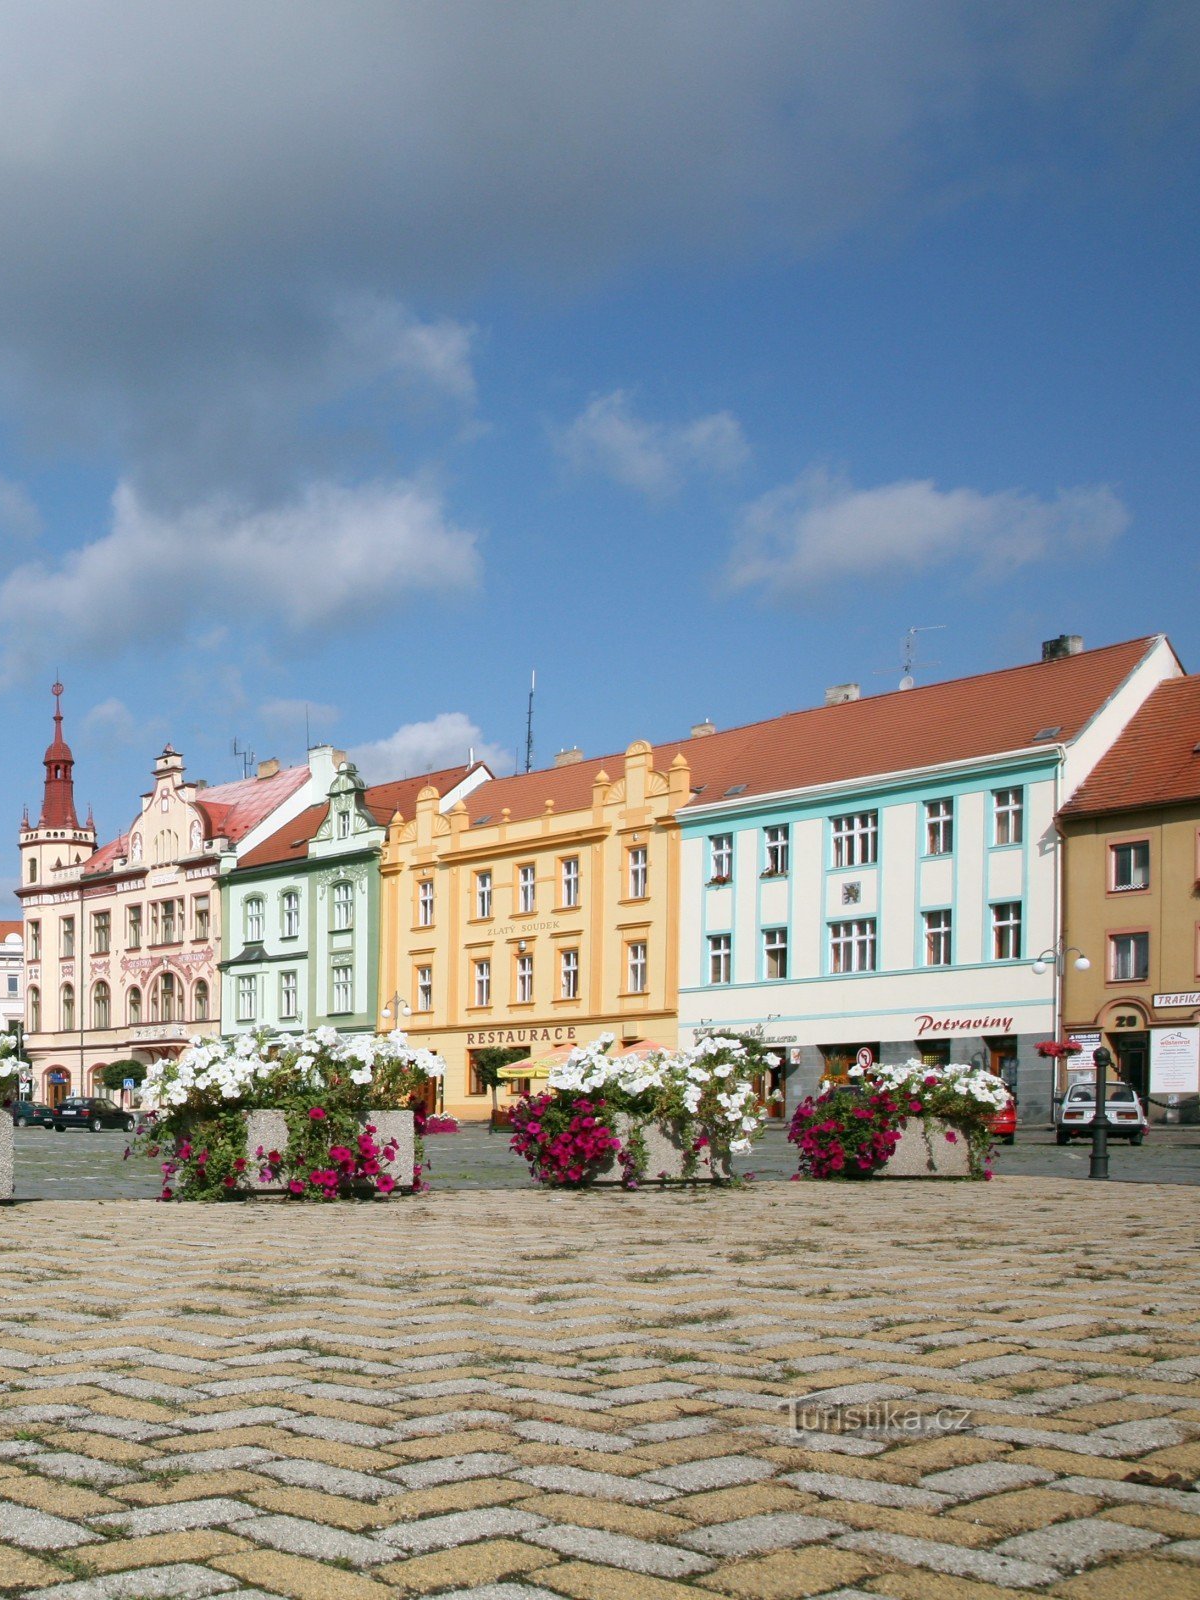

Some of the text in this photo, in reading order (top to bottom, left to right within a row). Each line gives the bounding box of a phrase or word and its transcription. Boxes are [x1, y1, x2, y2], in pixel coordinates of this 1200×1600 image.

[487, 921, 560, 936] ZLATÝ SOUDEK
[914, 1015, 1013, 1036] Potraviny
[466, 1027, 576, 1045] RESTAURACE
